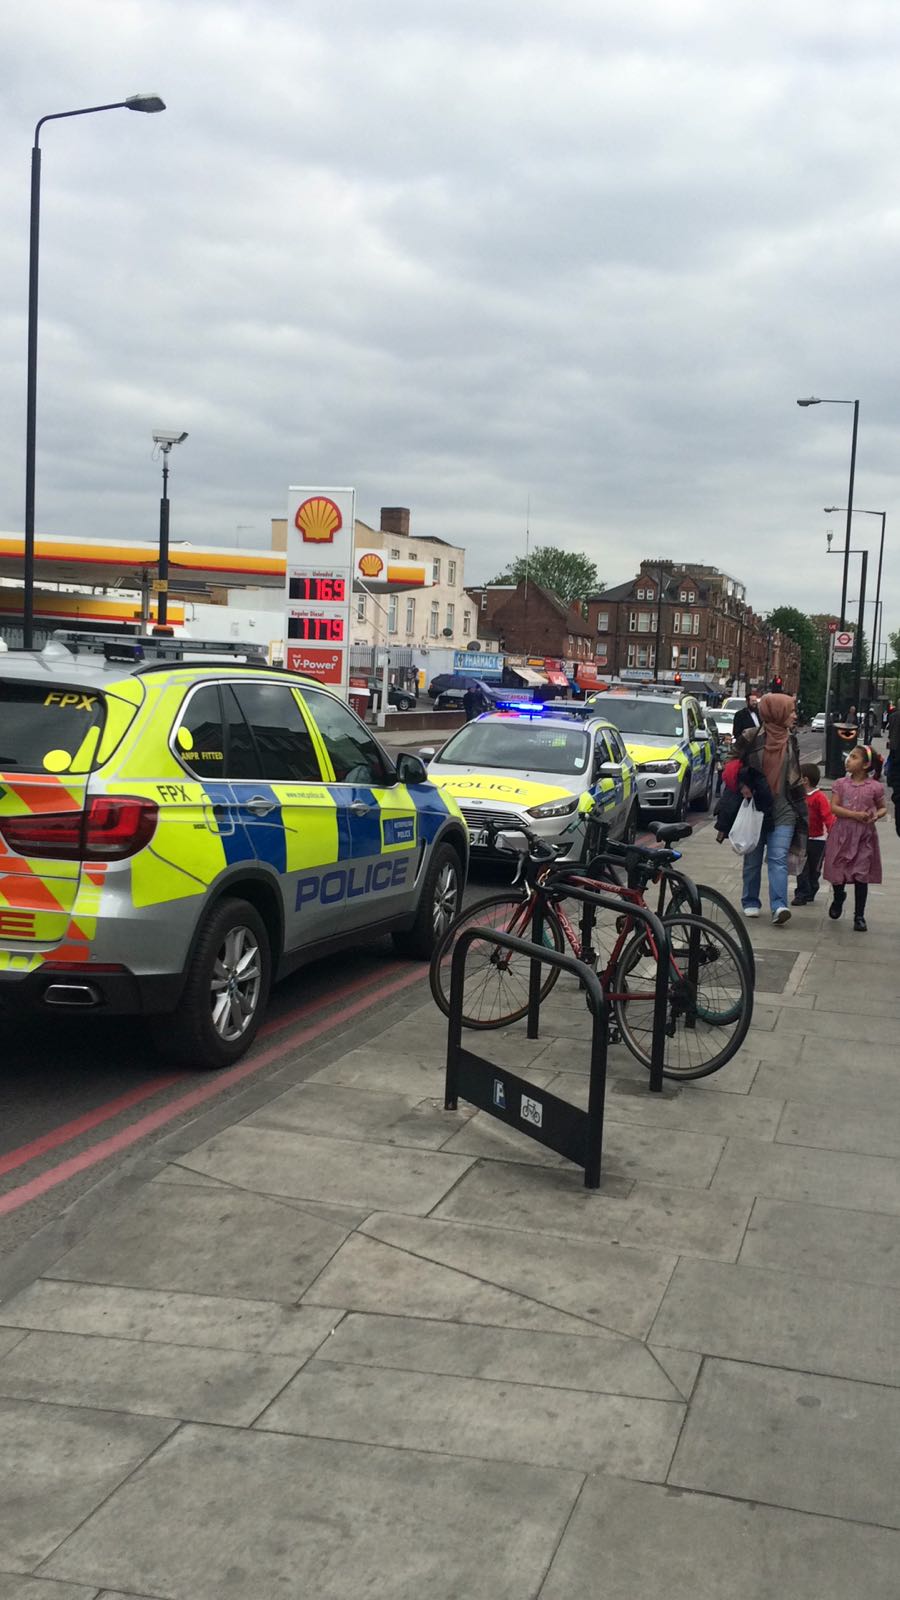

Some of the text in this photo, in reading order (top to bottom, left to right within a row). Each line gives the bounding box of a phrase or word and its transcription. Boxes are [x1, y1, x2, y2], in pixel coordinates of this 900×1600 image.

[292, 659, 336, 670] V-Power
[464, 654, 498, 669] PHARMACY
[43, 692, 98, 711] FPX
[181, 751, 224, 760] ANPR FITTED
[156, 785, 192, 802] FPX
[441, 780, 529, 796] POLICE
[295, 856, 410, 912] POLICE
